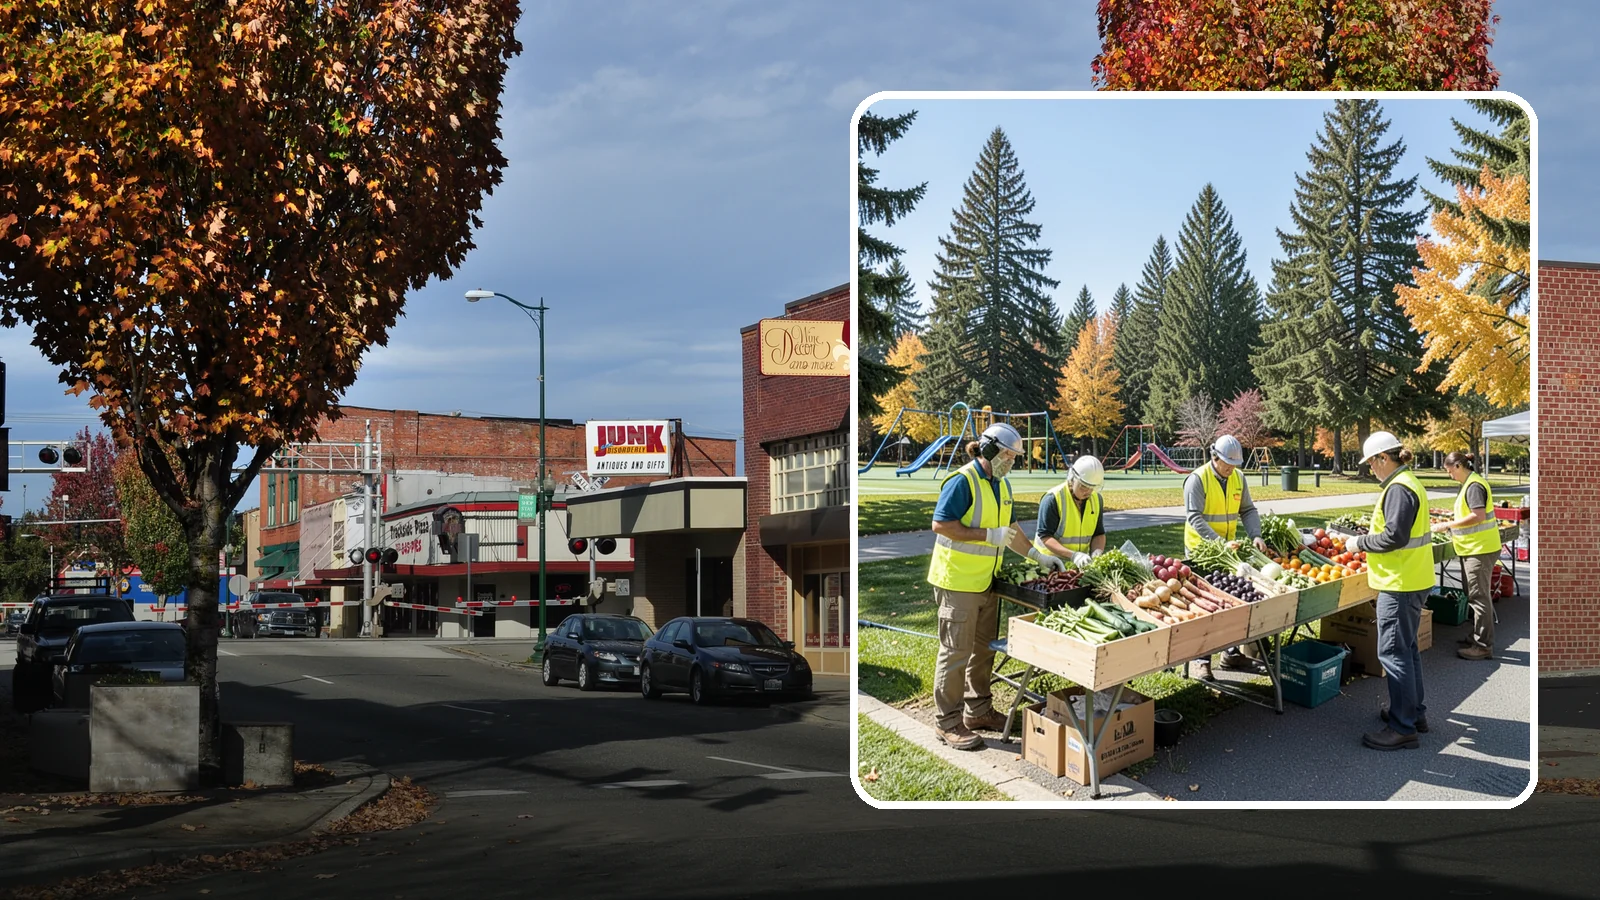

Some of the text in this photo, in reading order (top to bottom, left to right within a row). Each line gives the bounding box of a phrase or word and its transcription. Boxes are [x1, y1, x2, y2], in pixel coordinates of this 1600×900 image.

[765, 328, 831, 365] Decor
[596, 425, 665, 457] JUNK
[607, 446, 646, 454] DISORDERLY
[597, 460, 665, 470] ANTIQUES AND GIFTS
[390, 519, 429, 539] Trackside Pizza
